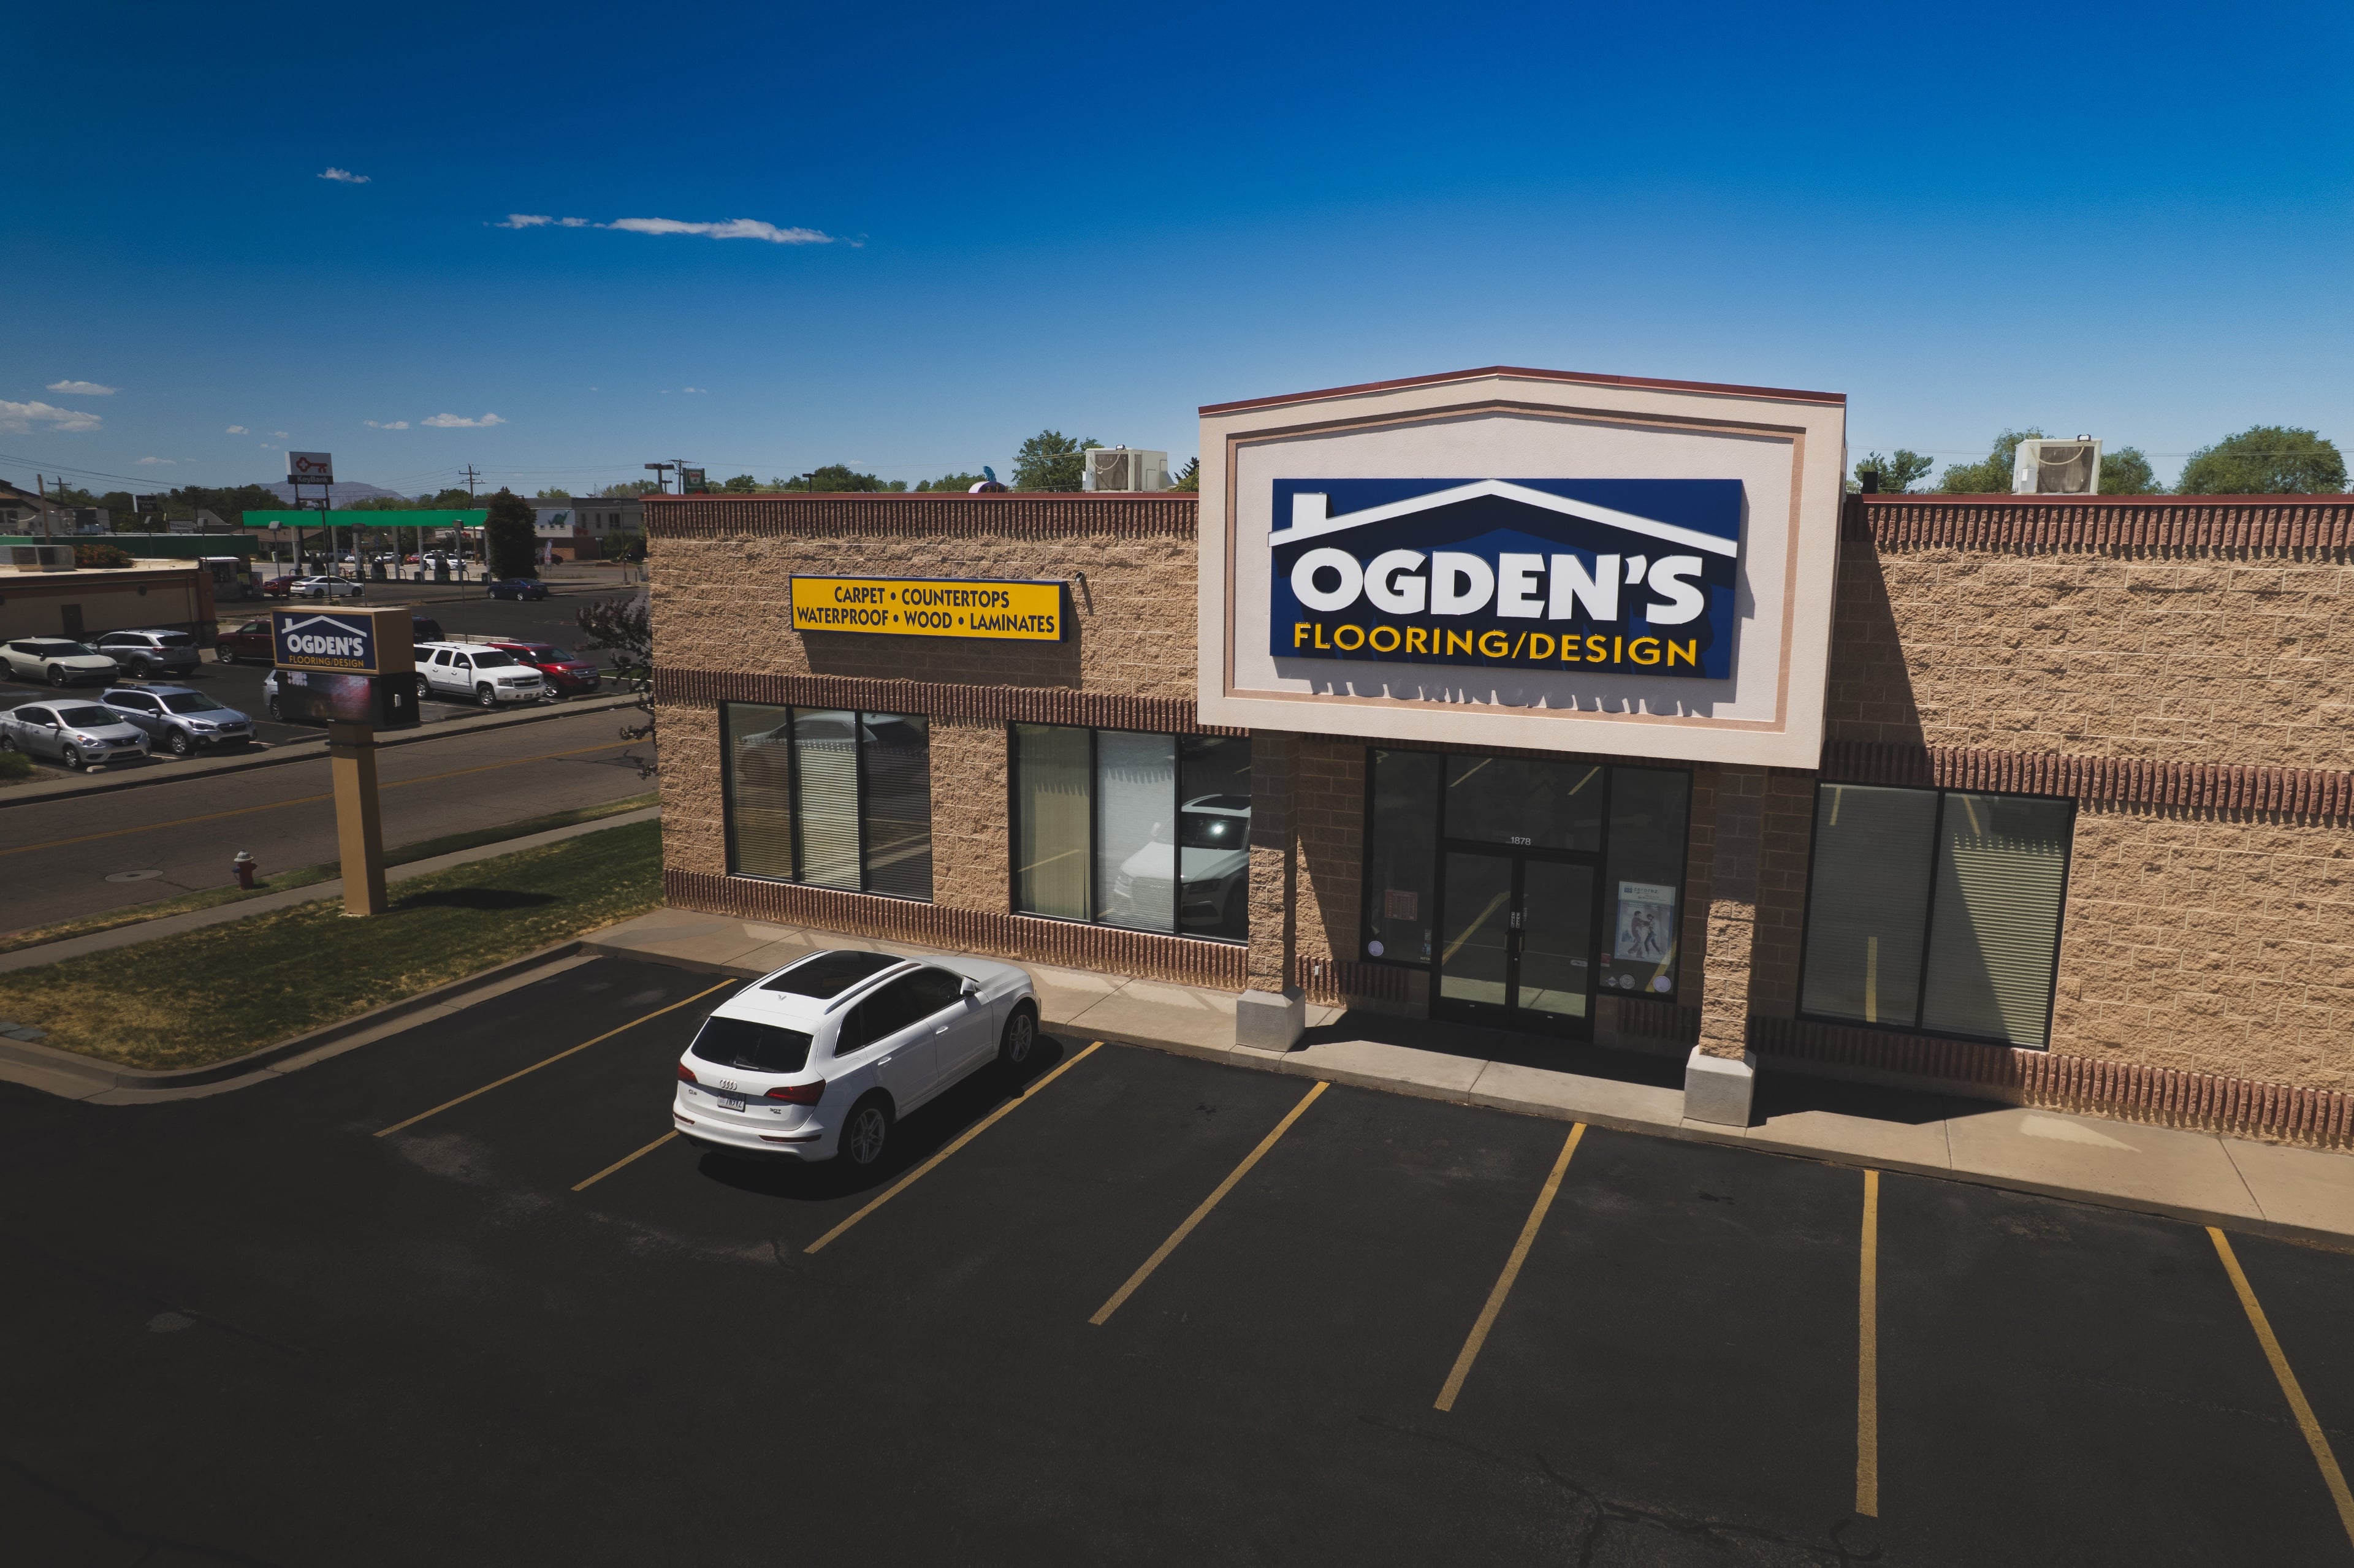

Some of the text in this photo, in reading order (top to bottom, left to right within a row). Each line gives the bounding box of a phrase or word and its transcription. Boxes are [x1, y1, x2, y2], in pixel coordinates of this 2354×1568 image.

[1290, 547, 1705, 624] OGDEN'S
[834, 586, 1010, 609] CARPET COUNTERTOPS
[797, 607, 1055, 633] WATERPROOF WOOD LAMINATES
[288, 634, 364, 657] OGDEN'S
[1293, 622, 1697, 667] FLOORING/DESIGN
[289, 656, 364, 667] FLOORING/DESIGN
[1510, 837, 1531, 845] 1878
